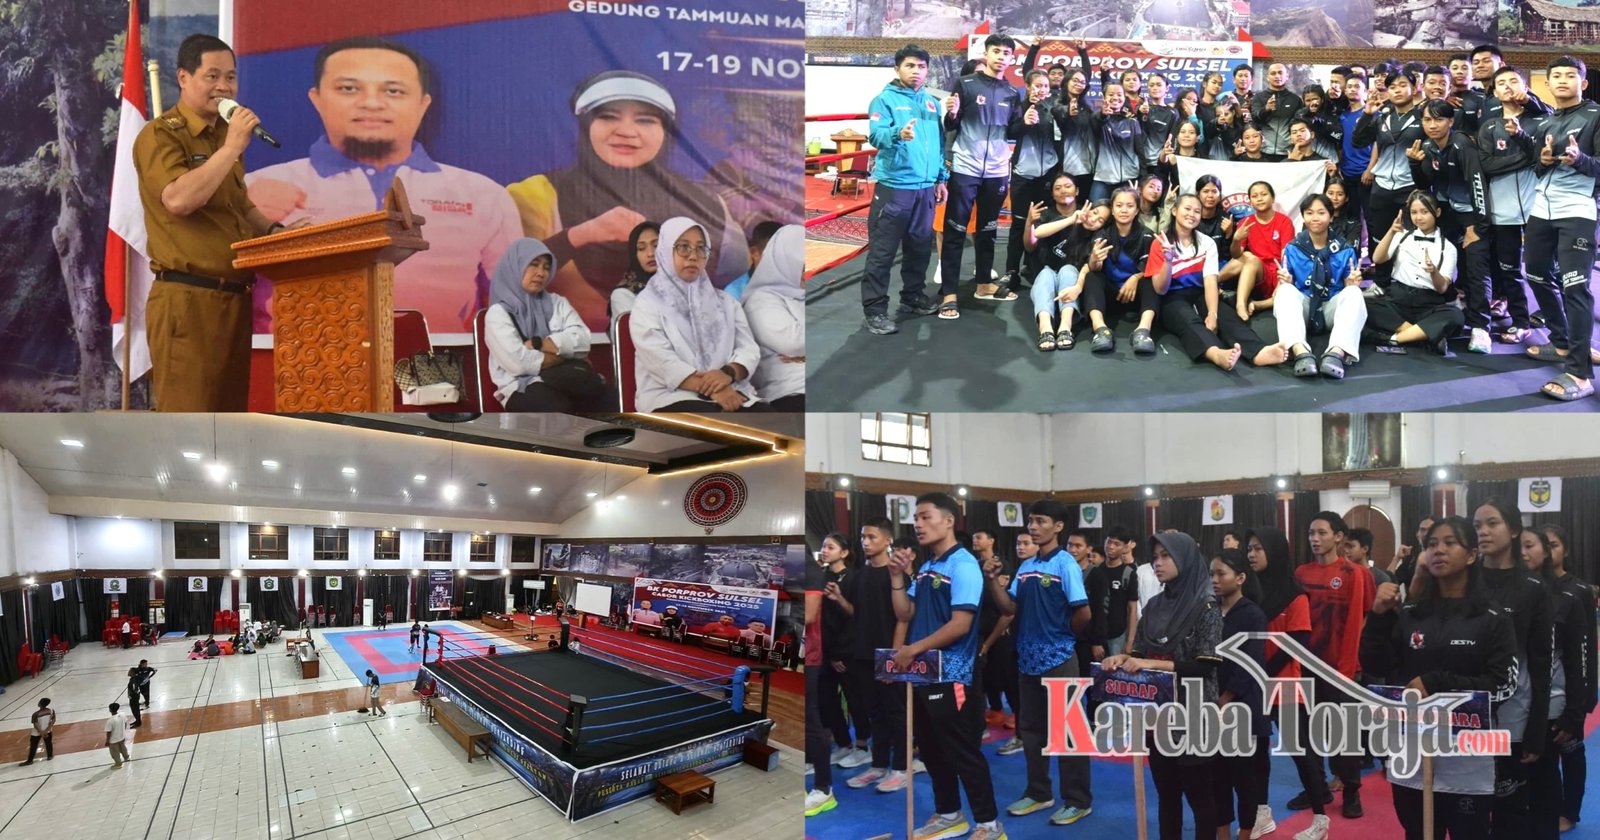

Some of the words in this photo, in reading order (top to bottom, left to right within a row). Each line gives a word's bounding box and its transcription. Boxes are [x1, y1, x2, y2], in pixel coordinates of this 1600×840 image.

[568, 0, 660, 18] GEDUNG
[666, 7, 769, 27] TAMMUAN
[656, 50, 741, 75] 17-19
[752, 56, 805, 78] NO
[1156, 58, 1231, 71] SULSEL
[662, 587, 715, 600] PORPROV
[717, 593, 763, 605] SULSEL
[678, 595, 731, 606] KICKBOXING
[734, 601, 759, 609] 2025
[886, 660, 927, 674] PPO
[1105, 679, 1158, 700] SIDRAP
[620, 764, 651, 781] SELAMAT
